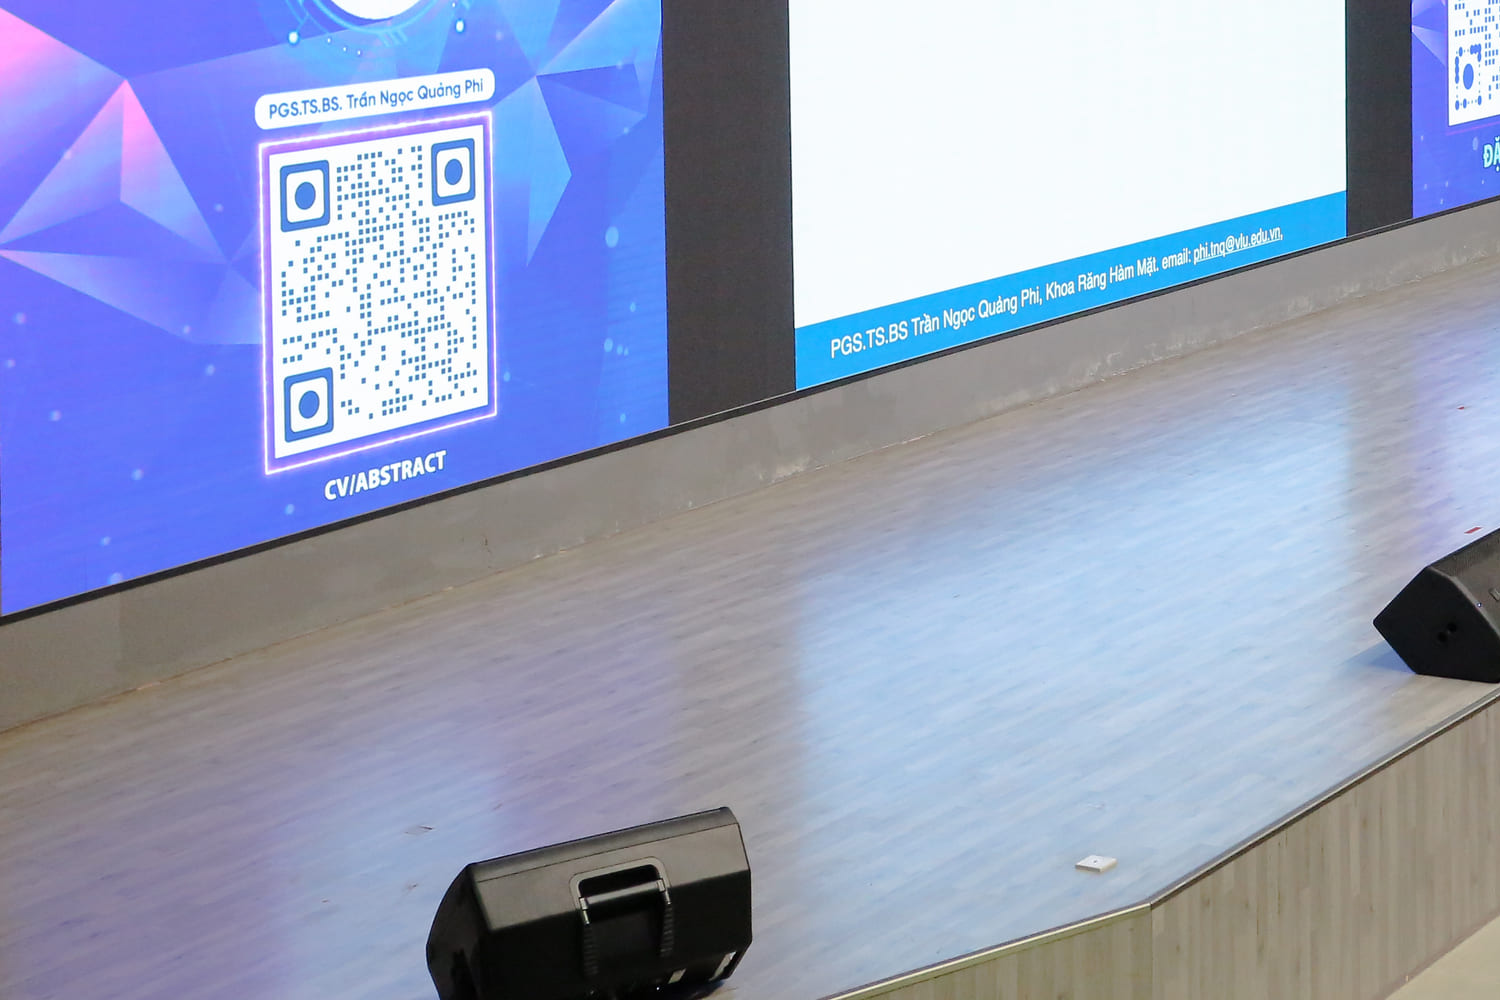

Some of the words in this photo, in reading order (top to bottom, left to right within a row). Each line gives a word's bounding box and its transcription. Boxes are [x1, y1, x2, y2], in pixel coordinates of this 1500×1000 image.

[268, 97, 343, 119] PGS.TS.BS.
[380, 89, 414, 107] Ngọc
[465, 78, 484, 94] Phi
[830, 321, 909, 359] PGS.TS.BS
[911, 312, 940, 336] Trần
[943, 306, 976, 330] Ngọc
[978, 295, 1018, 318] Quảng
[1021, 285, 1043, 308] Phi,
[1046, 278, 1075, 301] Khoa
[1077, 272, 1107, 292] Răng
[1109, 263, 1135, 284] Hàm
[1137, 257, 1160, 278] Mặt.
[1161, 250, 1192, 270] email:
[324, 449, 447, 501] CV/ABSTRACT
